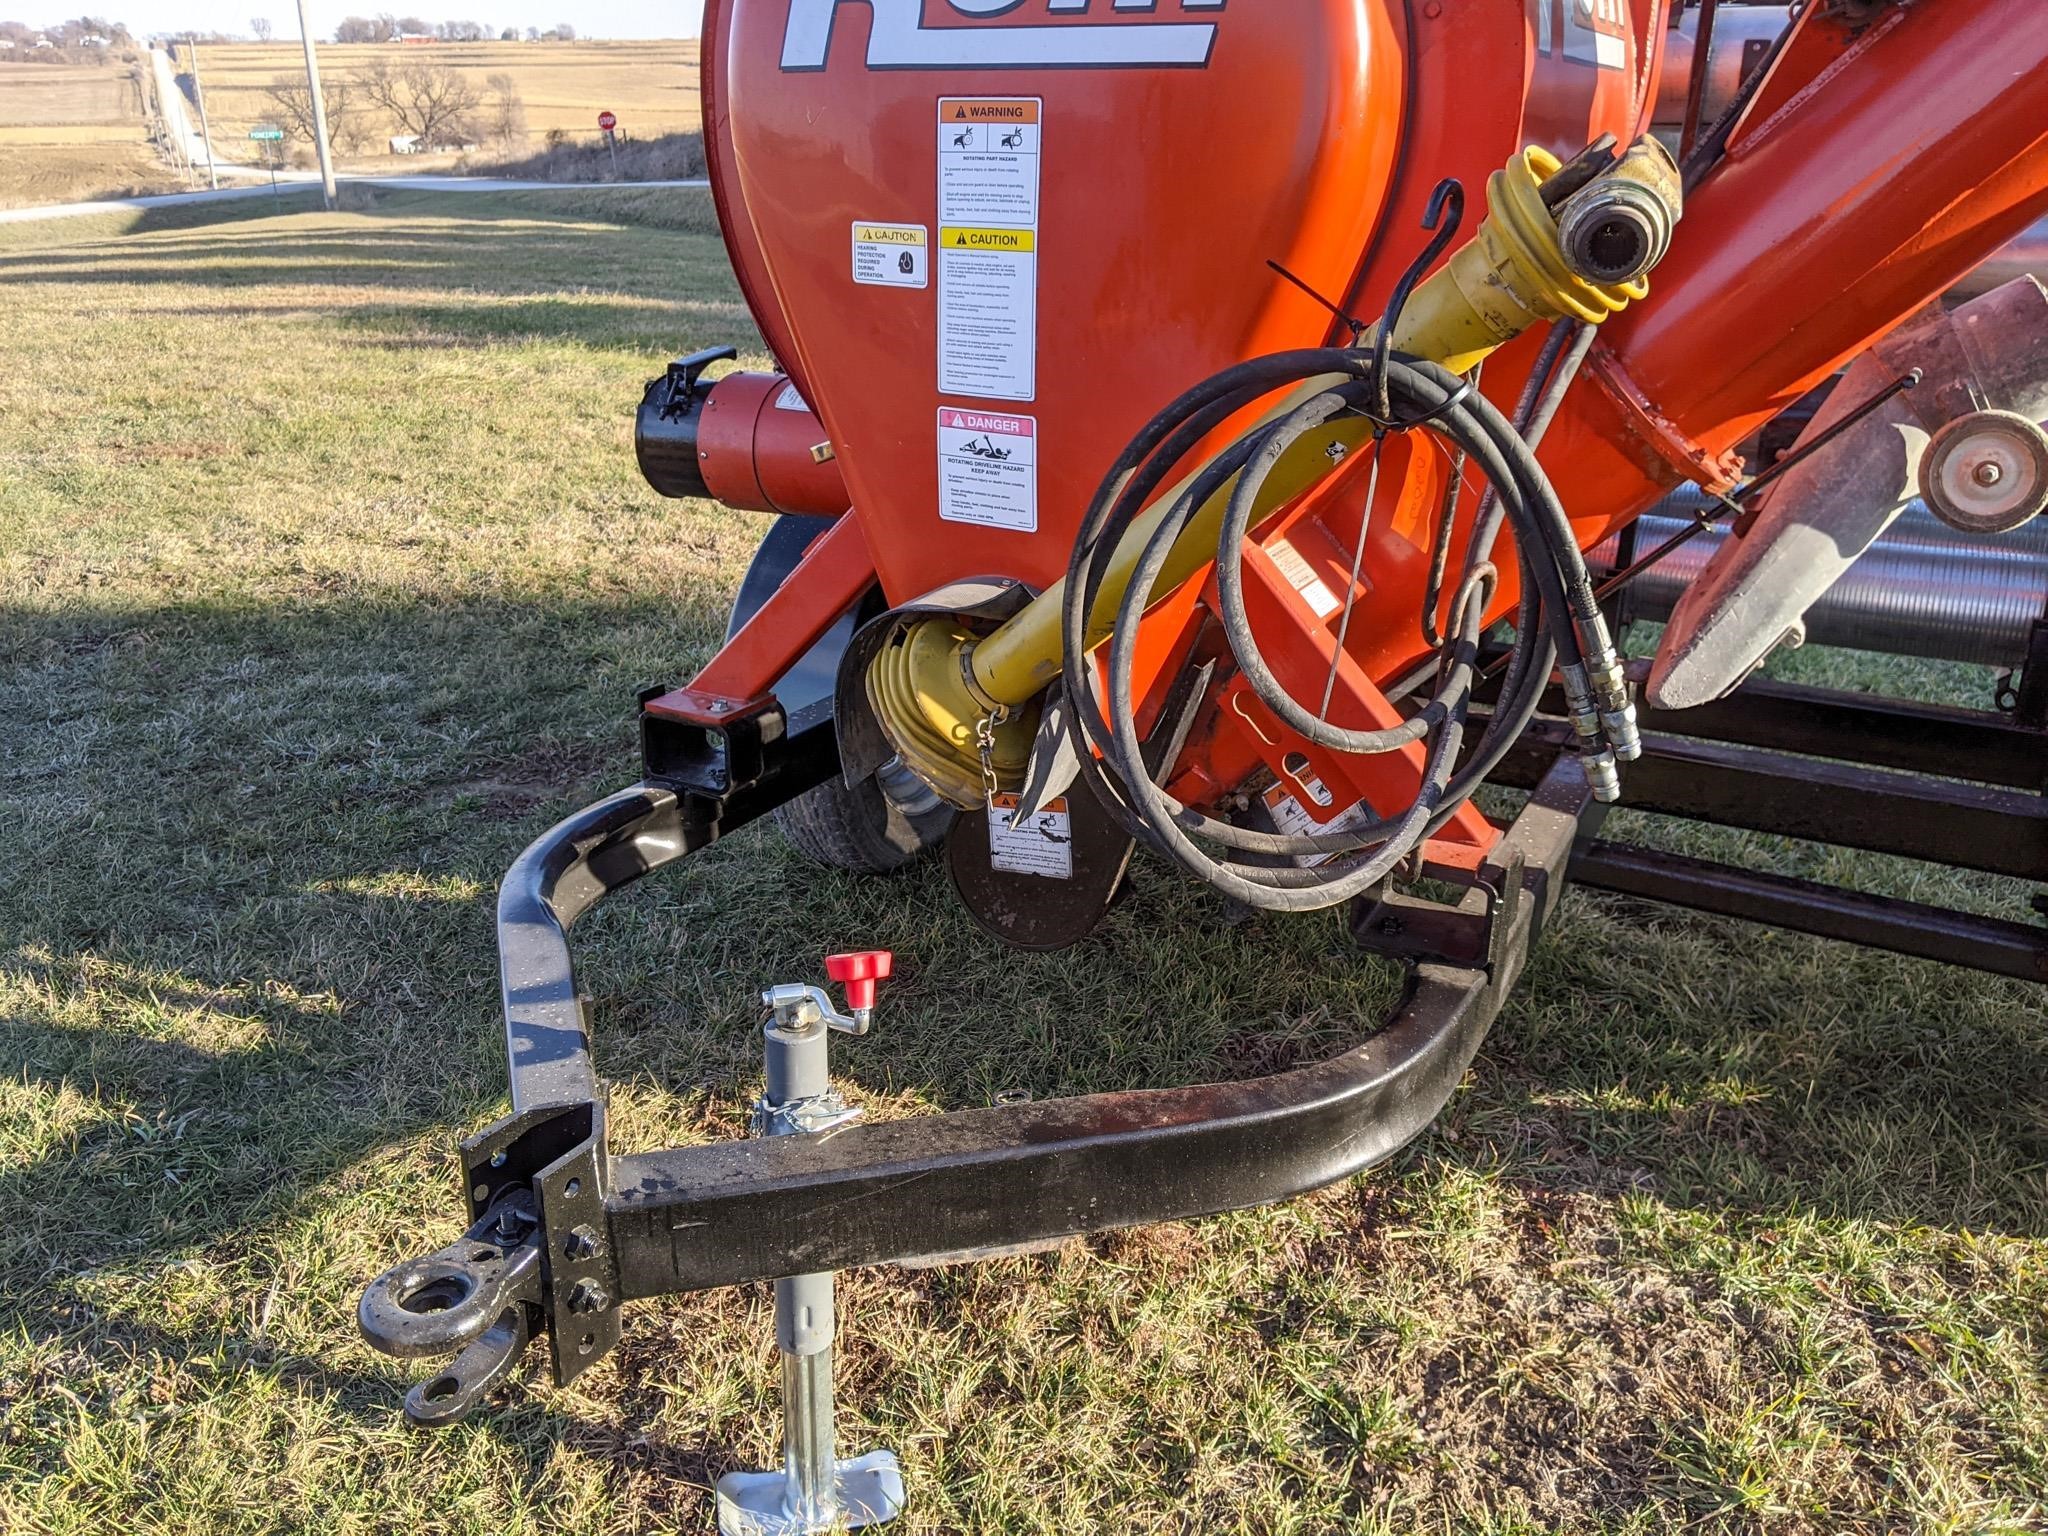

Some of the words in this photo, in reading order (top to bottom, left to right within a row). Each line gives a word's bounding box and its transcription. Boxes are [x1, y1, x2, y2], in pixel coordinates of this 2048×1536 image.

[970, 107, 1023, 117] WARNING
[600, 116, 615, 125] STOP
[874, 230, 917, 242] CAUTION
[970, 234, 1018, 246] CAUTION
[967, 416, 1019, 432] DANGER
